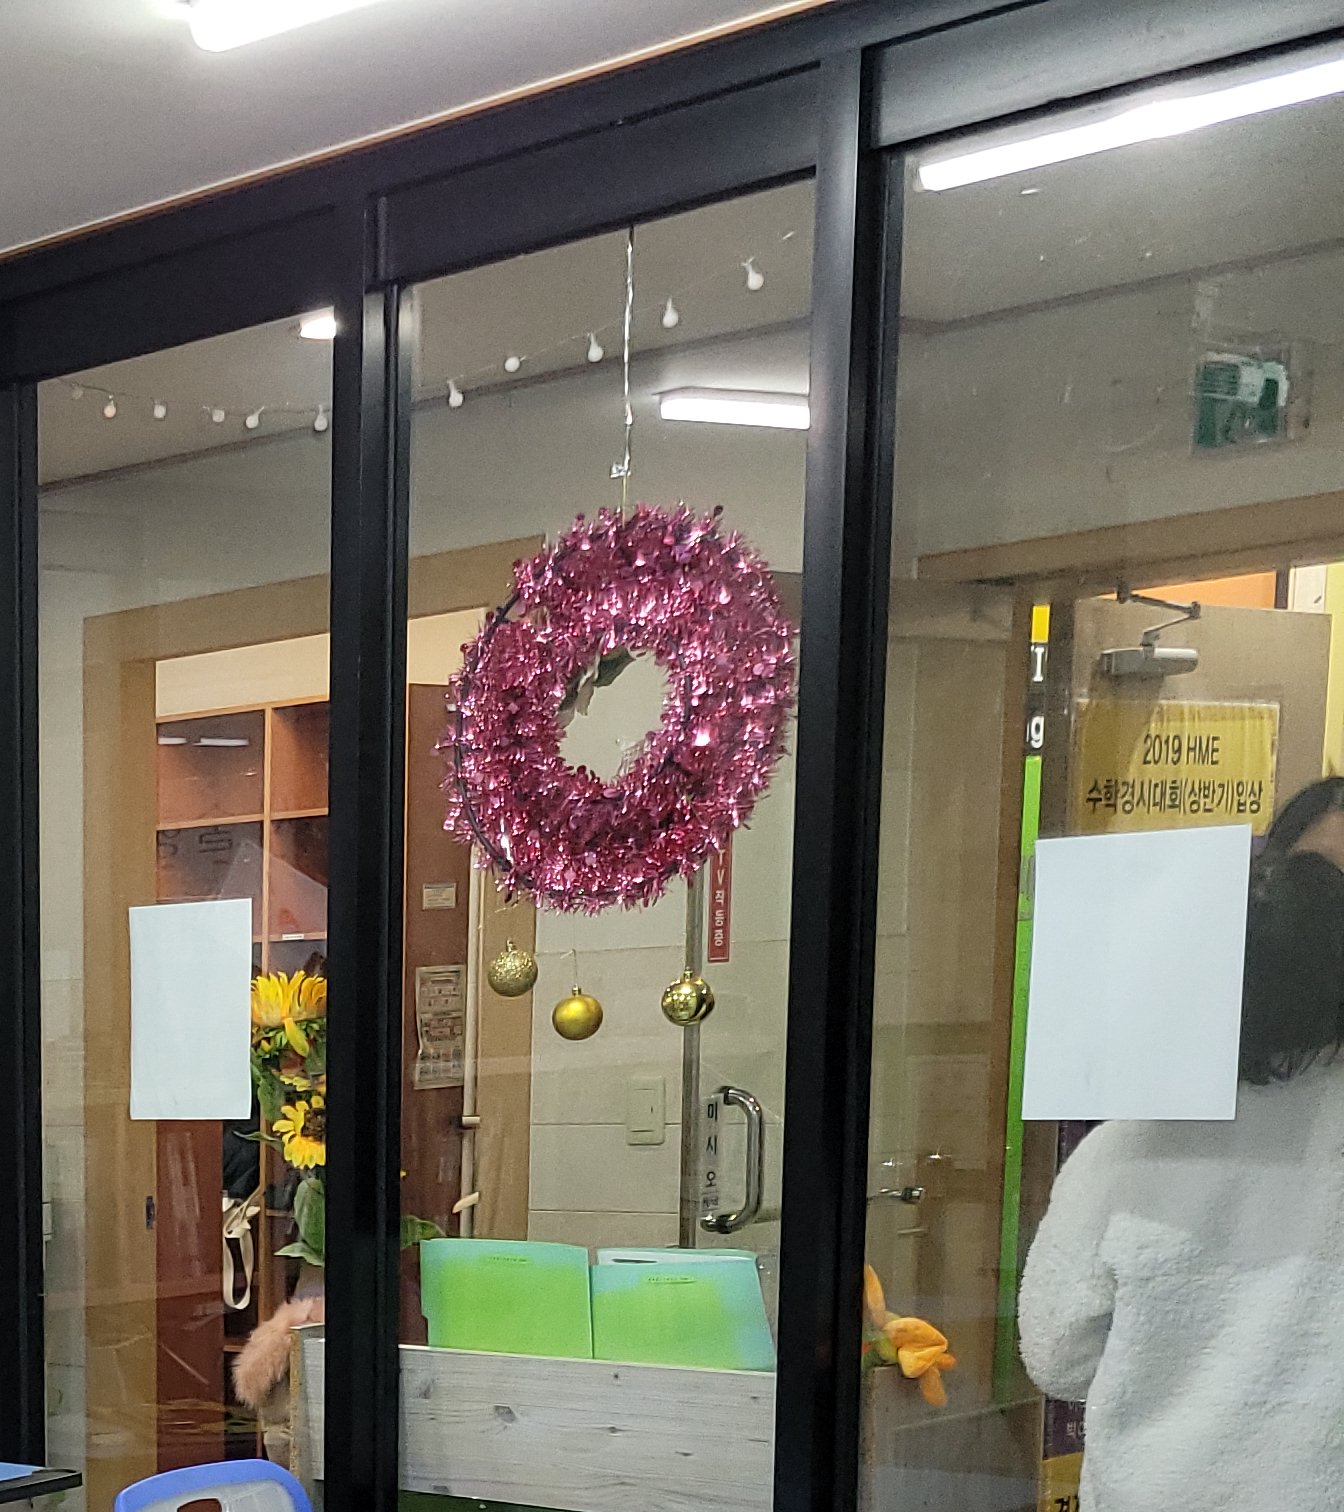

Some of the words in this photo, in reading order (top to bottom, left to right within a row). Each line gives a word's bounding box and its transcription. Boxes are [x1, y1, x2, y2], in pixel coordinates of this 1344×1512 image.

[1143, 734, 1182, 766] 2019
[1185, 735, 1221, 766] HME
[1086, 779, 1264, 815] 수학경시대회(상반기)입상
[705, 1100, 718, 1188] 미시오
